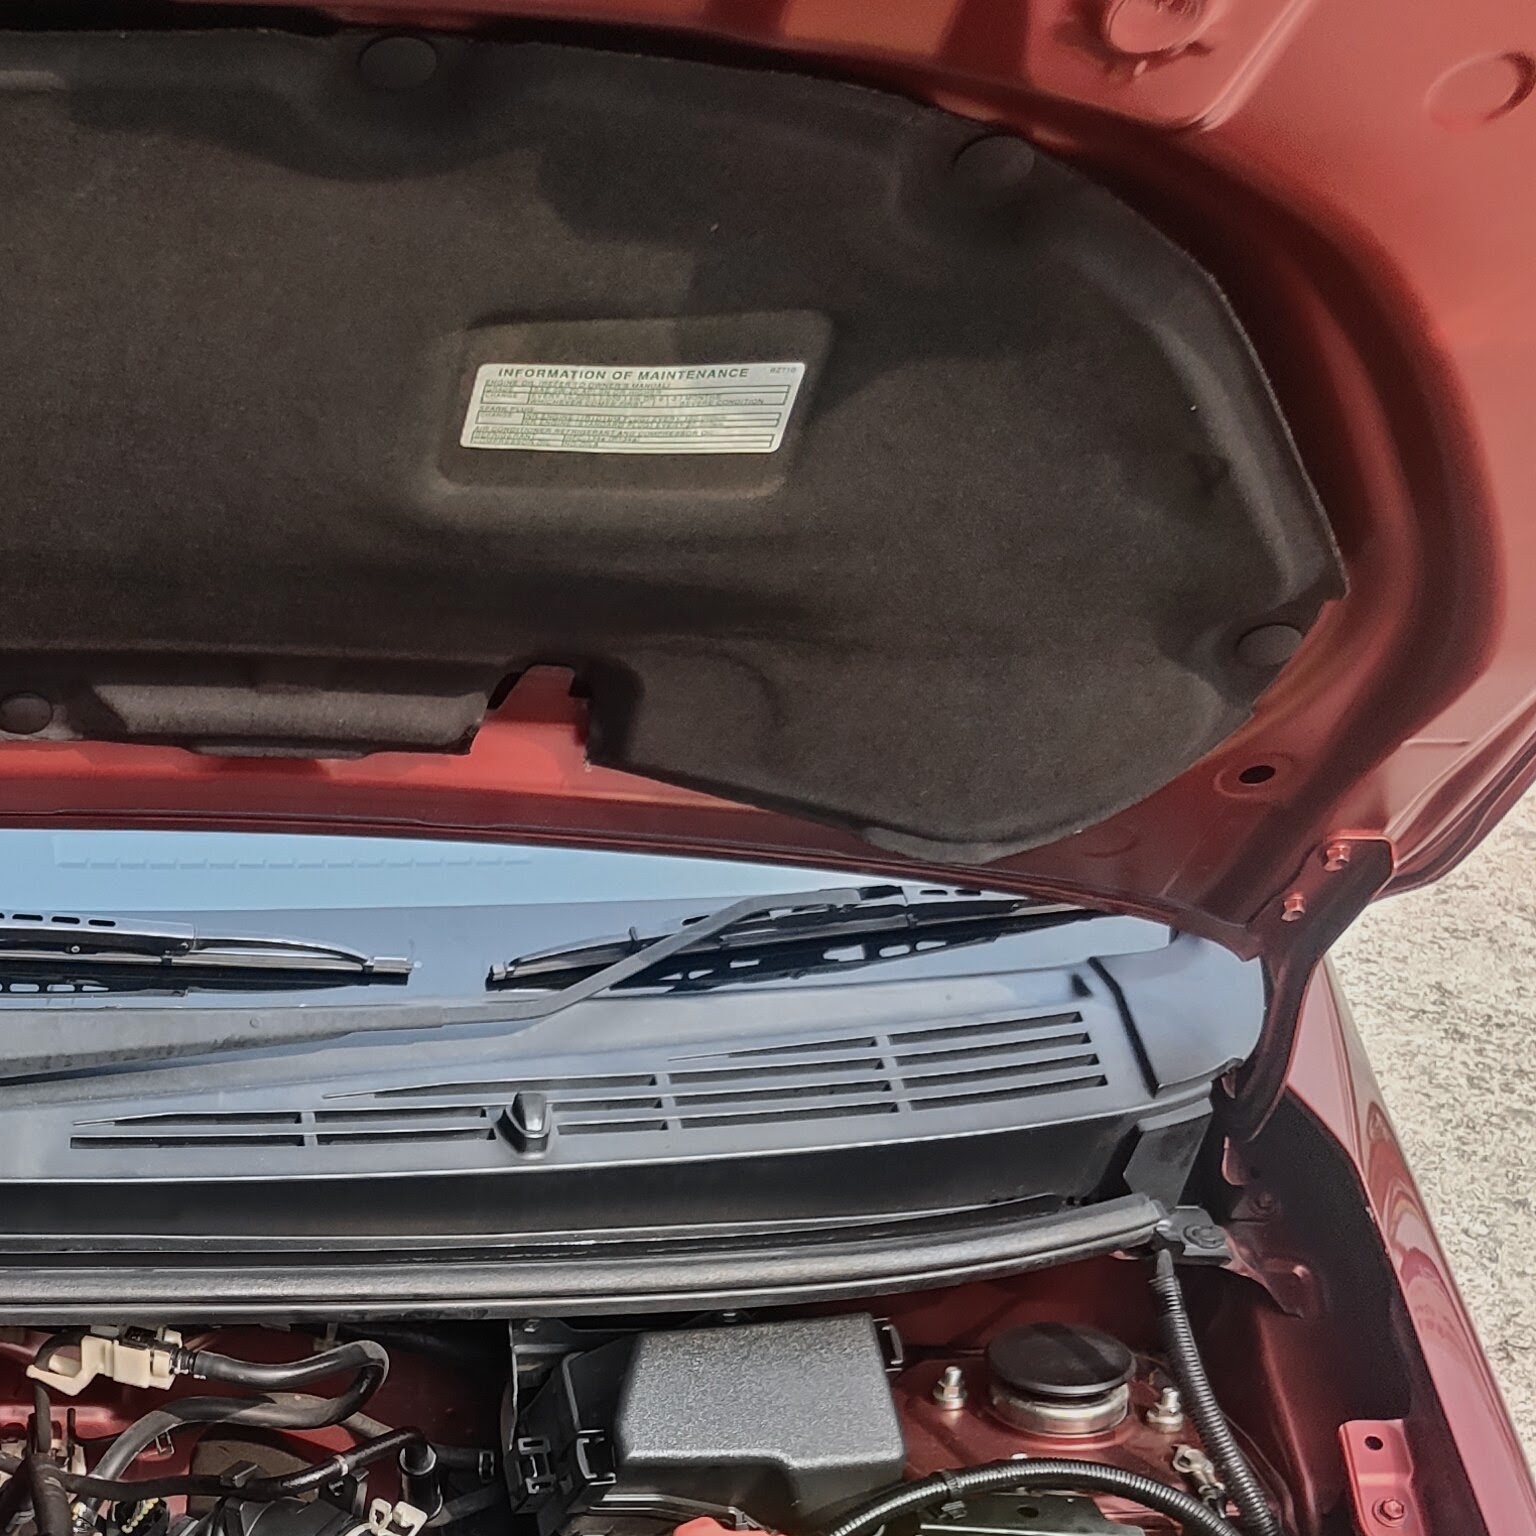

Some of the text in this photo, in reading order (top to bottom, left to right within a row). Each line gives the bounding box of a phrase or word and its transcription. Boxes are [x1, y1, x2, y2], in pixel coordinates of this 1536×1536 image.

[497, 367, 750, 381] INFORMATION OF MAINTENANCE
